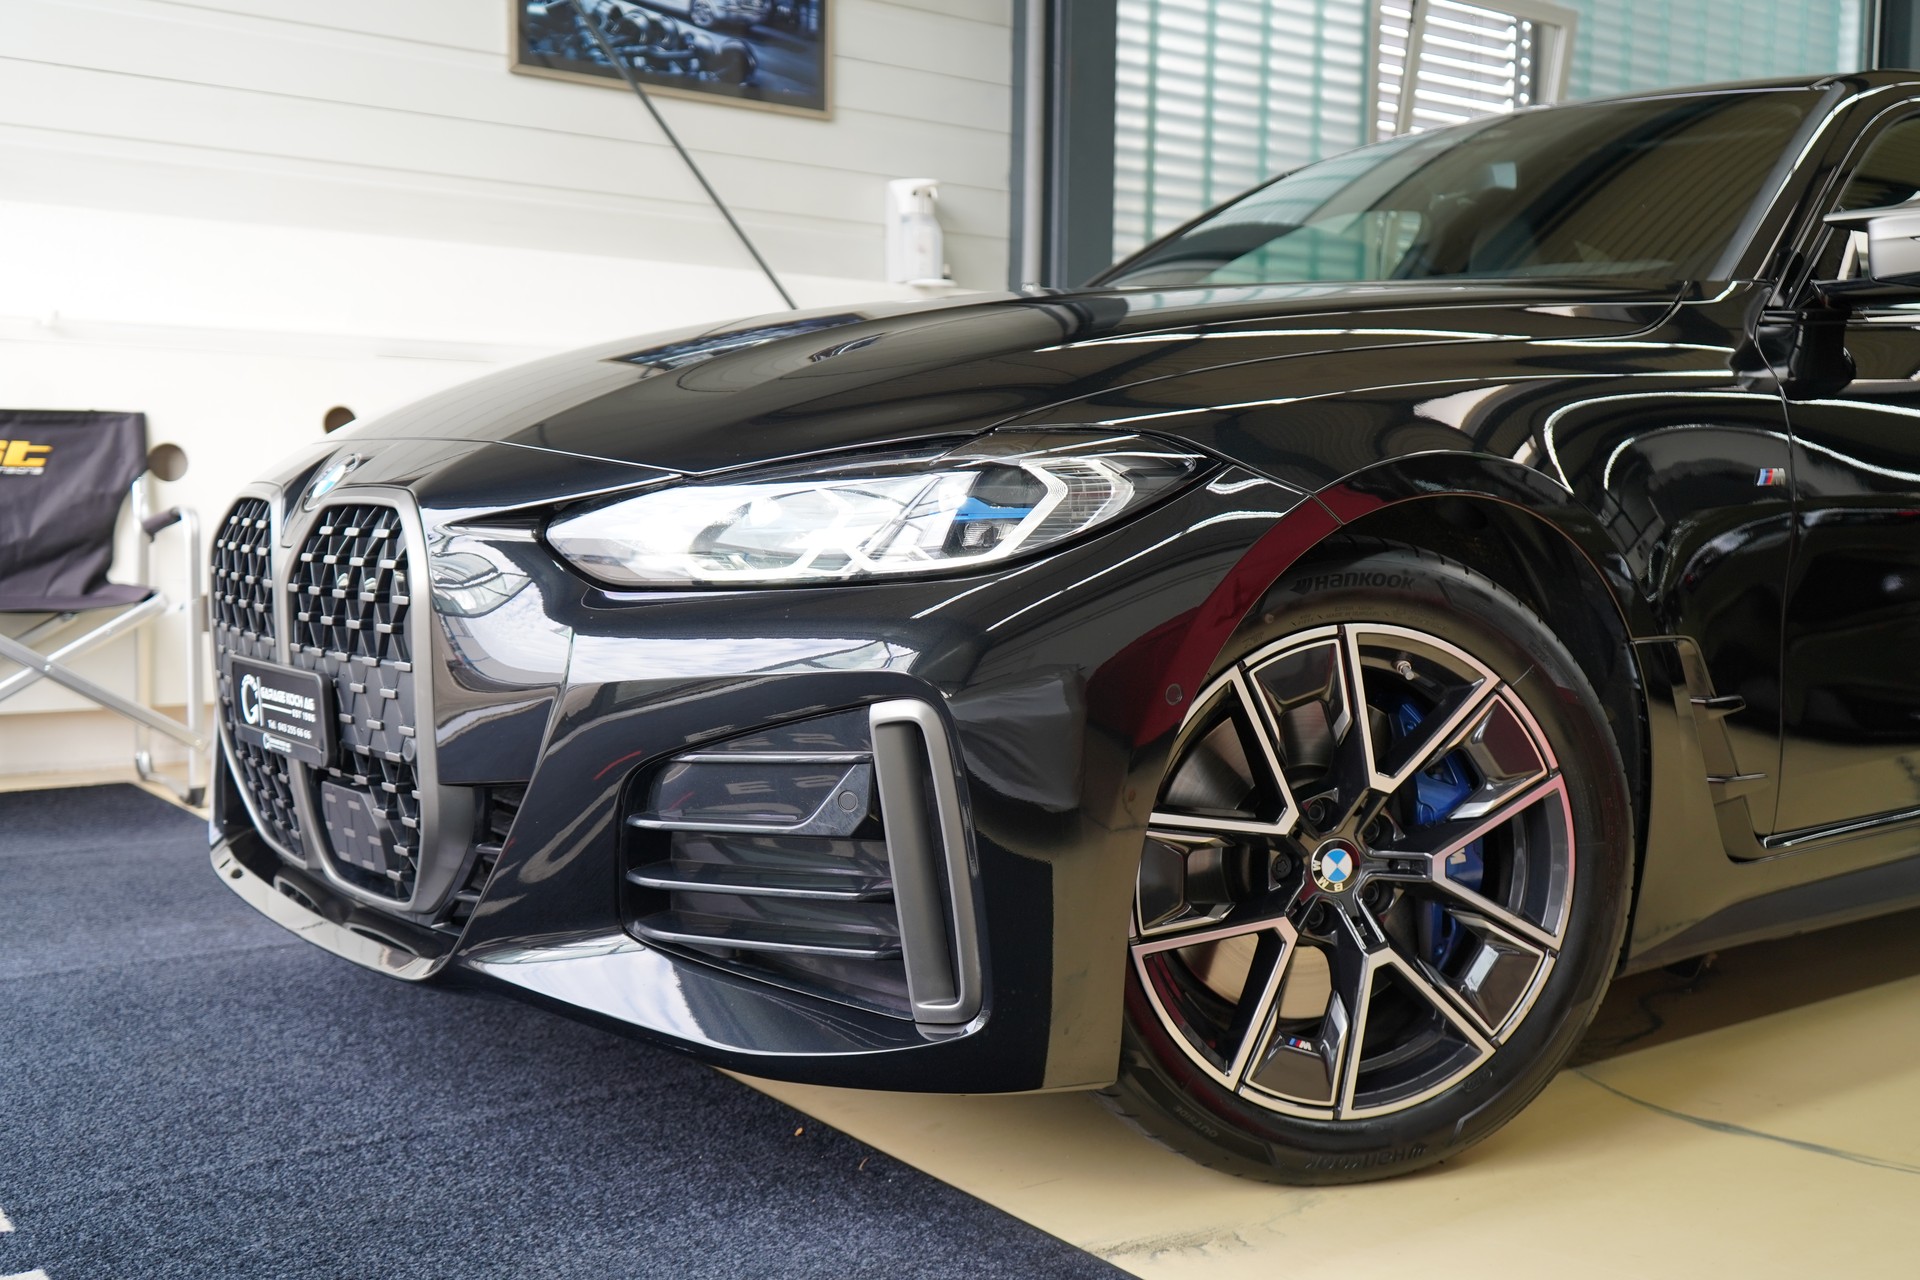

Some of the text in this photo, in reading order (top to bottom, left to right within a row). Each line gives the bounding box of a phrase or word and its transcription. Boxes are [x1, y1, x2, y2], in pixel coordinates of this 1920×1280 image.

[260, 686, 315, 711] GARAGE KOCH AG
[1312, 860, 1344, 892] BMW
